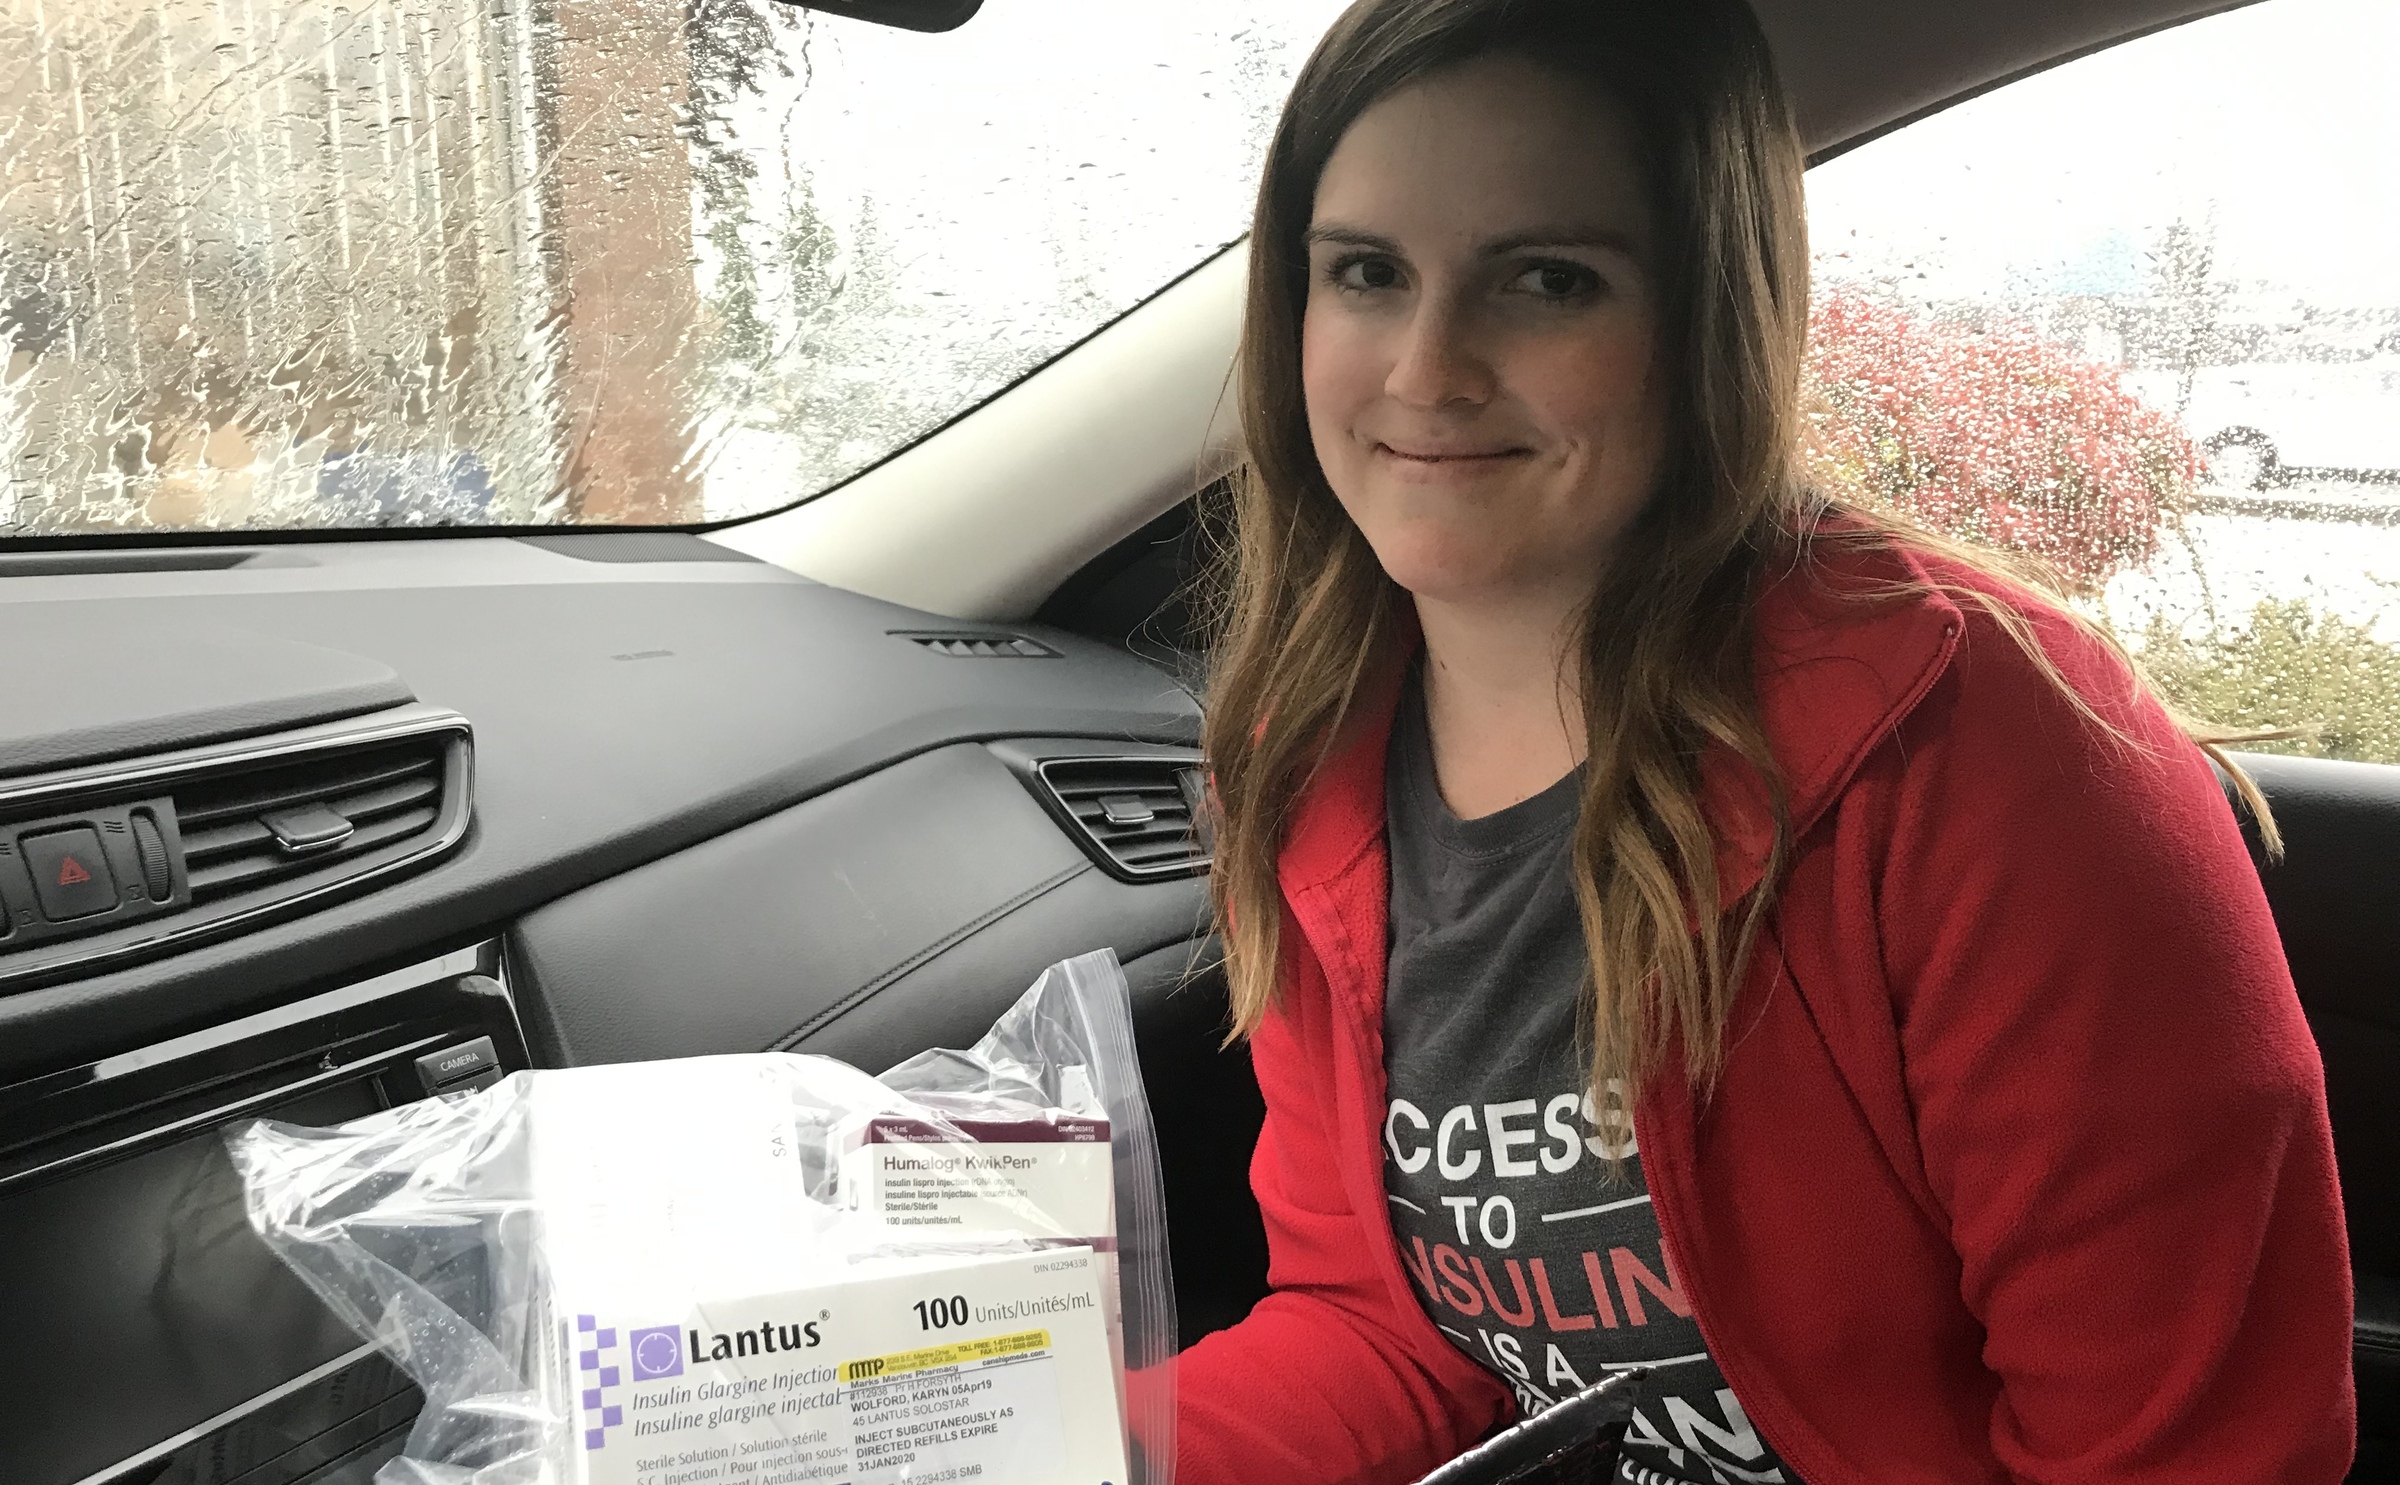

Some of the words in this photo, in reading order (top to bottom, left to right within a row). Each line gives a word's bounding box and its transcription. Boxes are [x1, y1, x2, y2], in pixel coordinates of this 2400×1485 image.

[440, 1053, 480, 1072] CAMERA
[1384, 1077, 1640, 1181] CCESS
[885, 1178, 911, 1187] insulin
[913, 1178, 935, 1189] lispro
[937, 1178, 970, 1188] injection
[885, 1190, 916, 1199] insuline
[917, 1190, 940, 1200] lispro
[941, 1189, 978, 1200] injectable
[885, 1201, 938, 1212] Sterile/Stérile
[885, 1216, 901, 1226] 100
[901, 1215, 963, 1226] units/unités/mL
[1440, 1195, 1516, 1250] TO
[1033, 1263, 1050, 1274] DIN
[1050, 1257, 1089, 1272] 02294338
[1400, 1236, 1695, 1332] NSULIN
[912, 1294, 970, 1331] 100
[975, 1291, 1095, 1324] Units/Unités/mL
[935, 1348, 950, 1357] Drive
[957, 1344, 973, 1353] TOLL
[982, 1350, 1046, 1367] canshipmeds.com
[1477, 1328, 1529, 1380] IS
[1545, 1343, 1588, 1388] A
[919, 1359, 929, 1367] BC
[850, 1378, 880, 1389] Marks
[882, 1372, 914, 1384] Marine
[915, 1364, 959, 1378] Pharmacy
[907, 1382, 915, 1391] H
[916, 1373, 963, 1389] FORSYTH
[633, 1384, 692, 1411] Insulin
[697, 1375, 768, 1402] Glargine
[851, 1394, 911, 1413] WOLFORD,
[912, 1385, 950, 1402] KARYN
[951, 1379, 993, 1396] 05Apr19
[634, 1410, 704, 1437] Insuline
[707, 1400, 776, 1429] glargine
[852, 1416, 866, 1427] 45
[867, 1407, 911, 1424] LANTUS
[913, 1396, 970, 1417] SOLOSTAR
[854, 1428, 894, 1445] INJECT
[896, 1409, 998, 1438] SUBCUTANEOUSLY
[998, 1406, 1014, 1419] AS
[636, 1453, 675, 1472] Sterile
[679, 1446, 729, 1465] Solution
[739, 1438, 789, 1455] Solution
[792, 1429, 829, 1447] stérile
[856, 1438, 912, 1459] DIRECTED
[914, 1430, 959, 1448] REFILLS
[960, 1422, 999, 1439] EXPIRE
[664, 1465, 719, 1485] Injection
[730, 1460, 758, 1475] Pour
[761, 1452, 813, 1472] injection
[762, 1462, 850, 1485] Antidiabétique
[857, 1452, 917, 1473] 31JAN2020
[915, 1469, 958, 1485] 2294338
[959, 1463, 983, 1478] SMB
